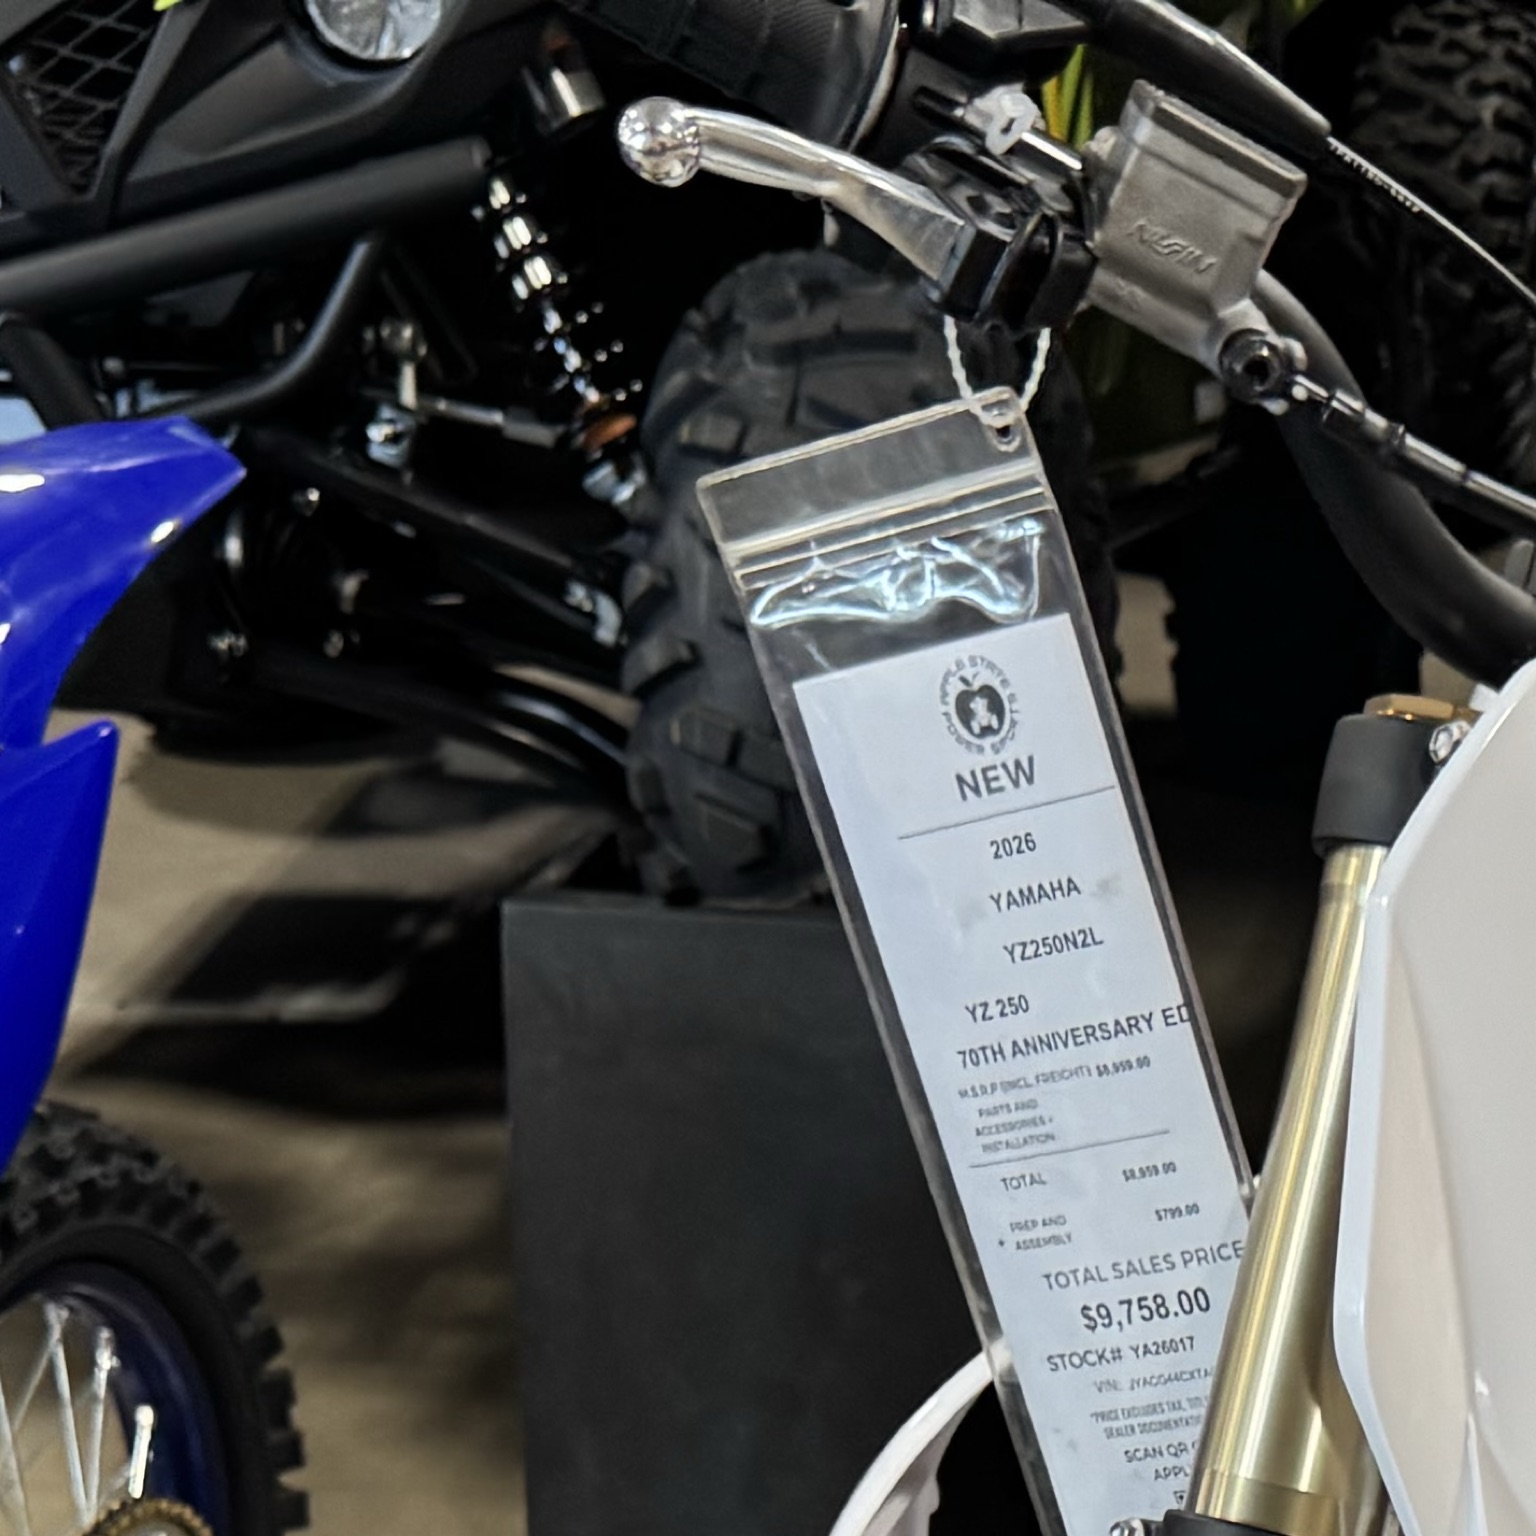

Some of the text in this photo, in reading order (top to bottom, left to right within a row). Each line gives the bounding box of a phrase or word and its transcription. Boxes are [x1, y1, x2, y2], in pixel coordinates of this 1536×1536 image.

[956, 755, 1034, 801] NEW
[990, 832, 1036, 859] 2026
[990, 877, 1081, 912] YAMAHA
[1003, 927, 1103, 963] YZ250N2L
[965, 995, 1029, 1023] YZ 250
[957, 1042, 1006, 1068] 70TH
[1012, 1012, 1153, 1058] ANNIVERSARY
[1001, 1173, 1046, 1191] TOTAL
[1042, 1239, 1244, 1290] TOTAL SALES PRICE
[1081, 1287, 1210, 1332] $9,758.00
[1047, 1336, 1194, 1371] STOCK# YA26017
[1124, 1447, 1163, 1463] SCAN
[1167, 1442, 1188, 1458] QR
[1154, 1464, 1189, 1482] APPL
